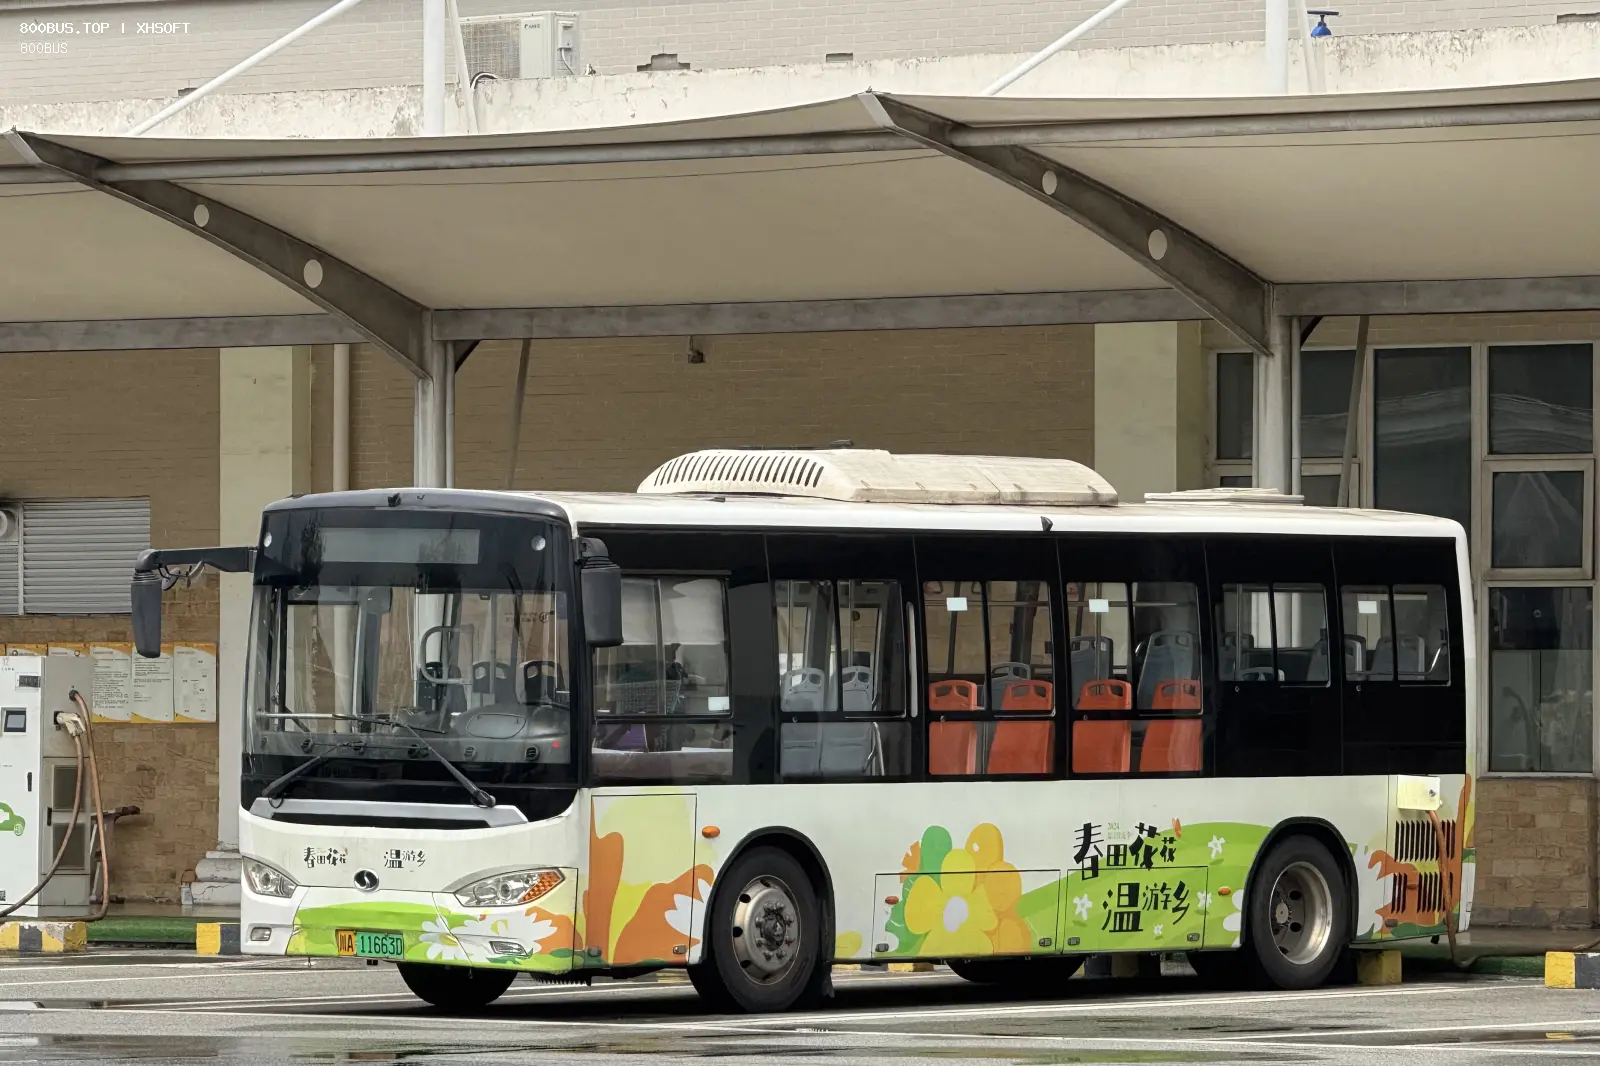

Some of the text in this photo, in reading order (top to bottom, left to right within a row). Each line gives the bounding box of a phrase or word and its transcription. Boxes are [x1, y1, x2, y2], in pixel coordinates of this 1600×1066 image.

[384, 848, 426, 868] 温游乡
[1073, 822, 1177, 881] 春田花花
[1101, 880, 1190, 933] 温游乡
[360, 935, 403, 956] 11663D
